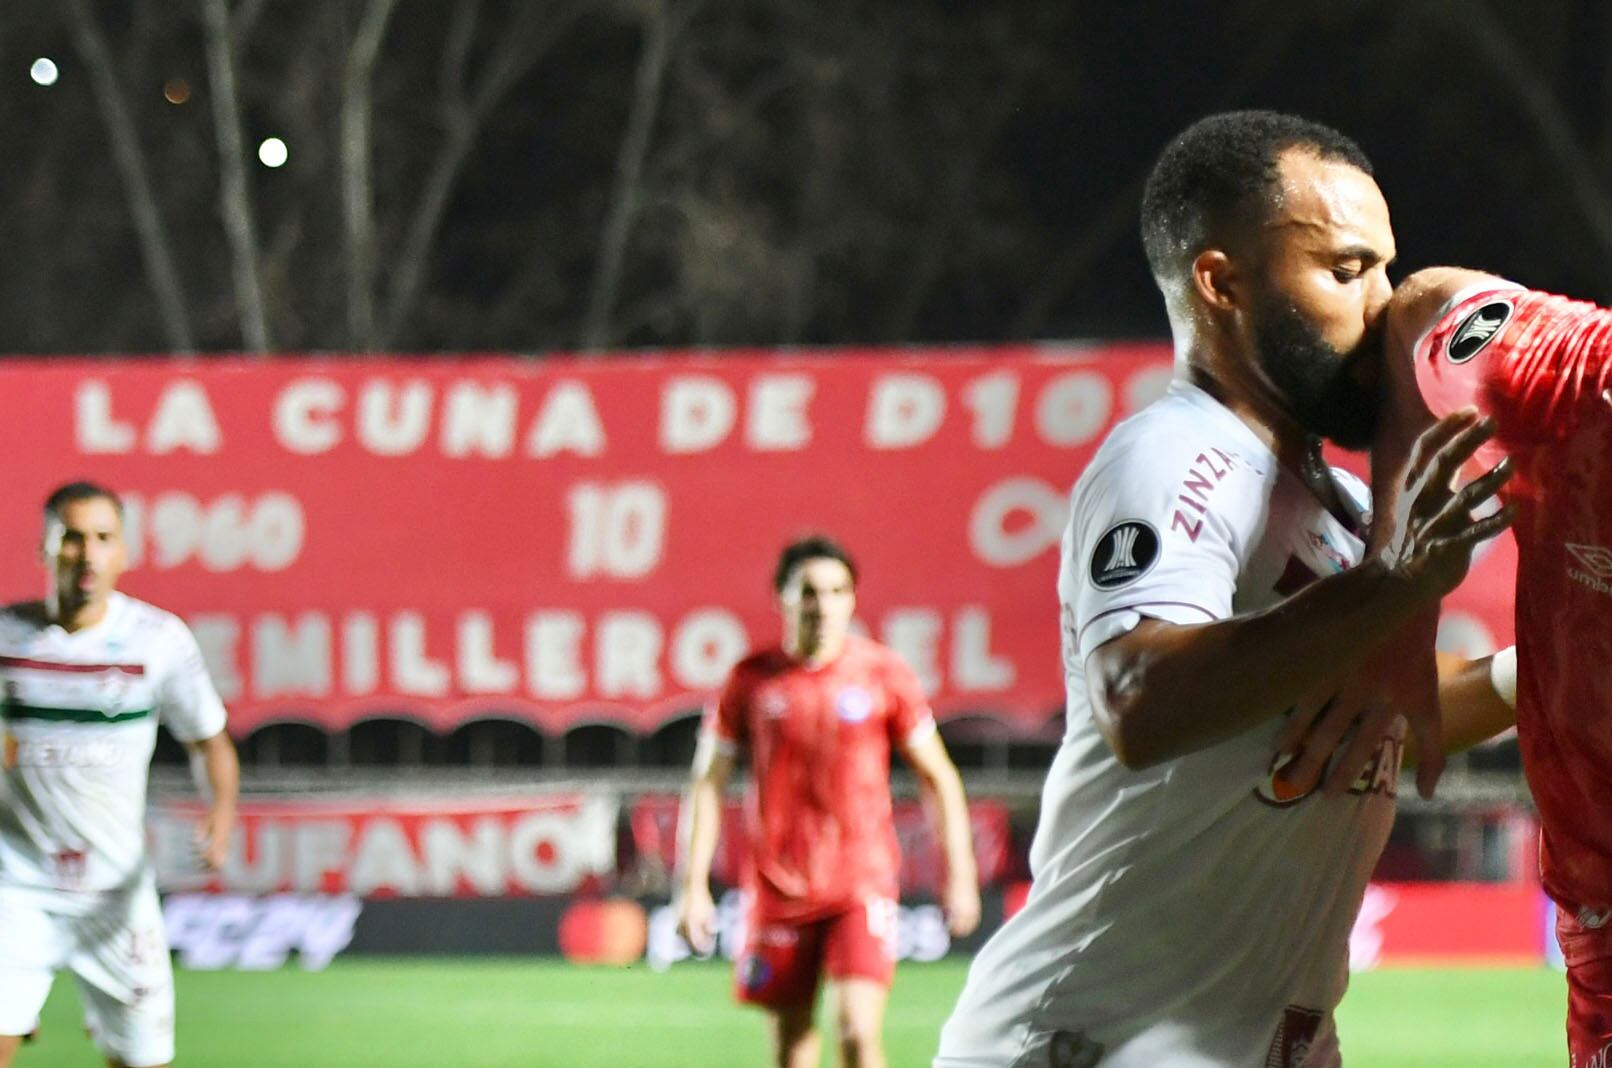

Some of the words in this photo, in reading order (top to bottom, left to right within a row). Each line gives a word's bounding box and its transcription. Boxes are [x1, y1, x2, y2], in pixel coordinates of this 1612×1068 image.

[74, 379, 224, 456] LA
[271, 376, 607, 460] CUNA
[657, 373, 817, 454] DE
[124, 490, 304, 572] 1960
[566, 480, 667, 580] 10
[186, 609, 750, 701] EMILLERO
[848, 603, 1017, 699] EL
